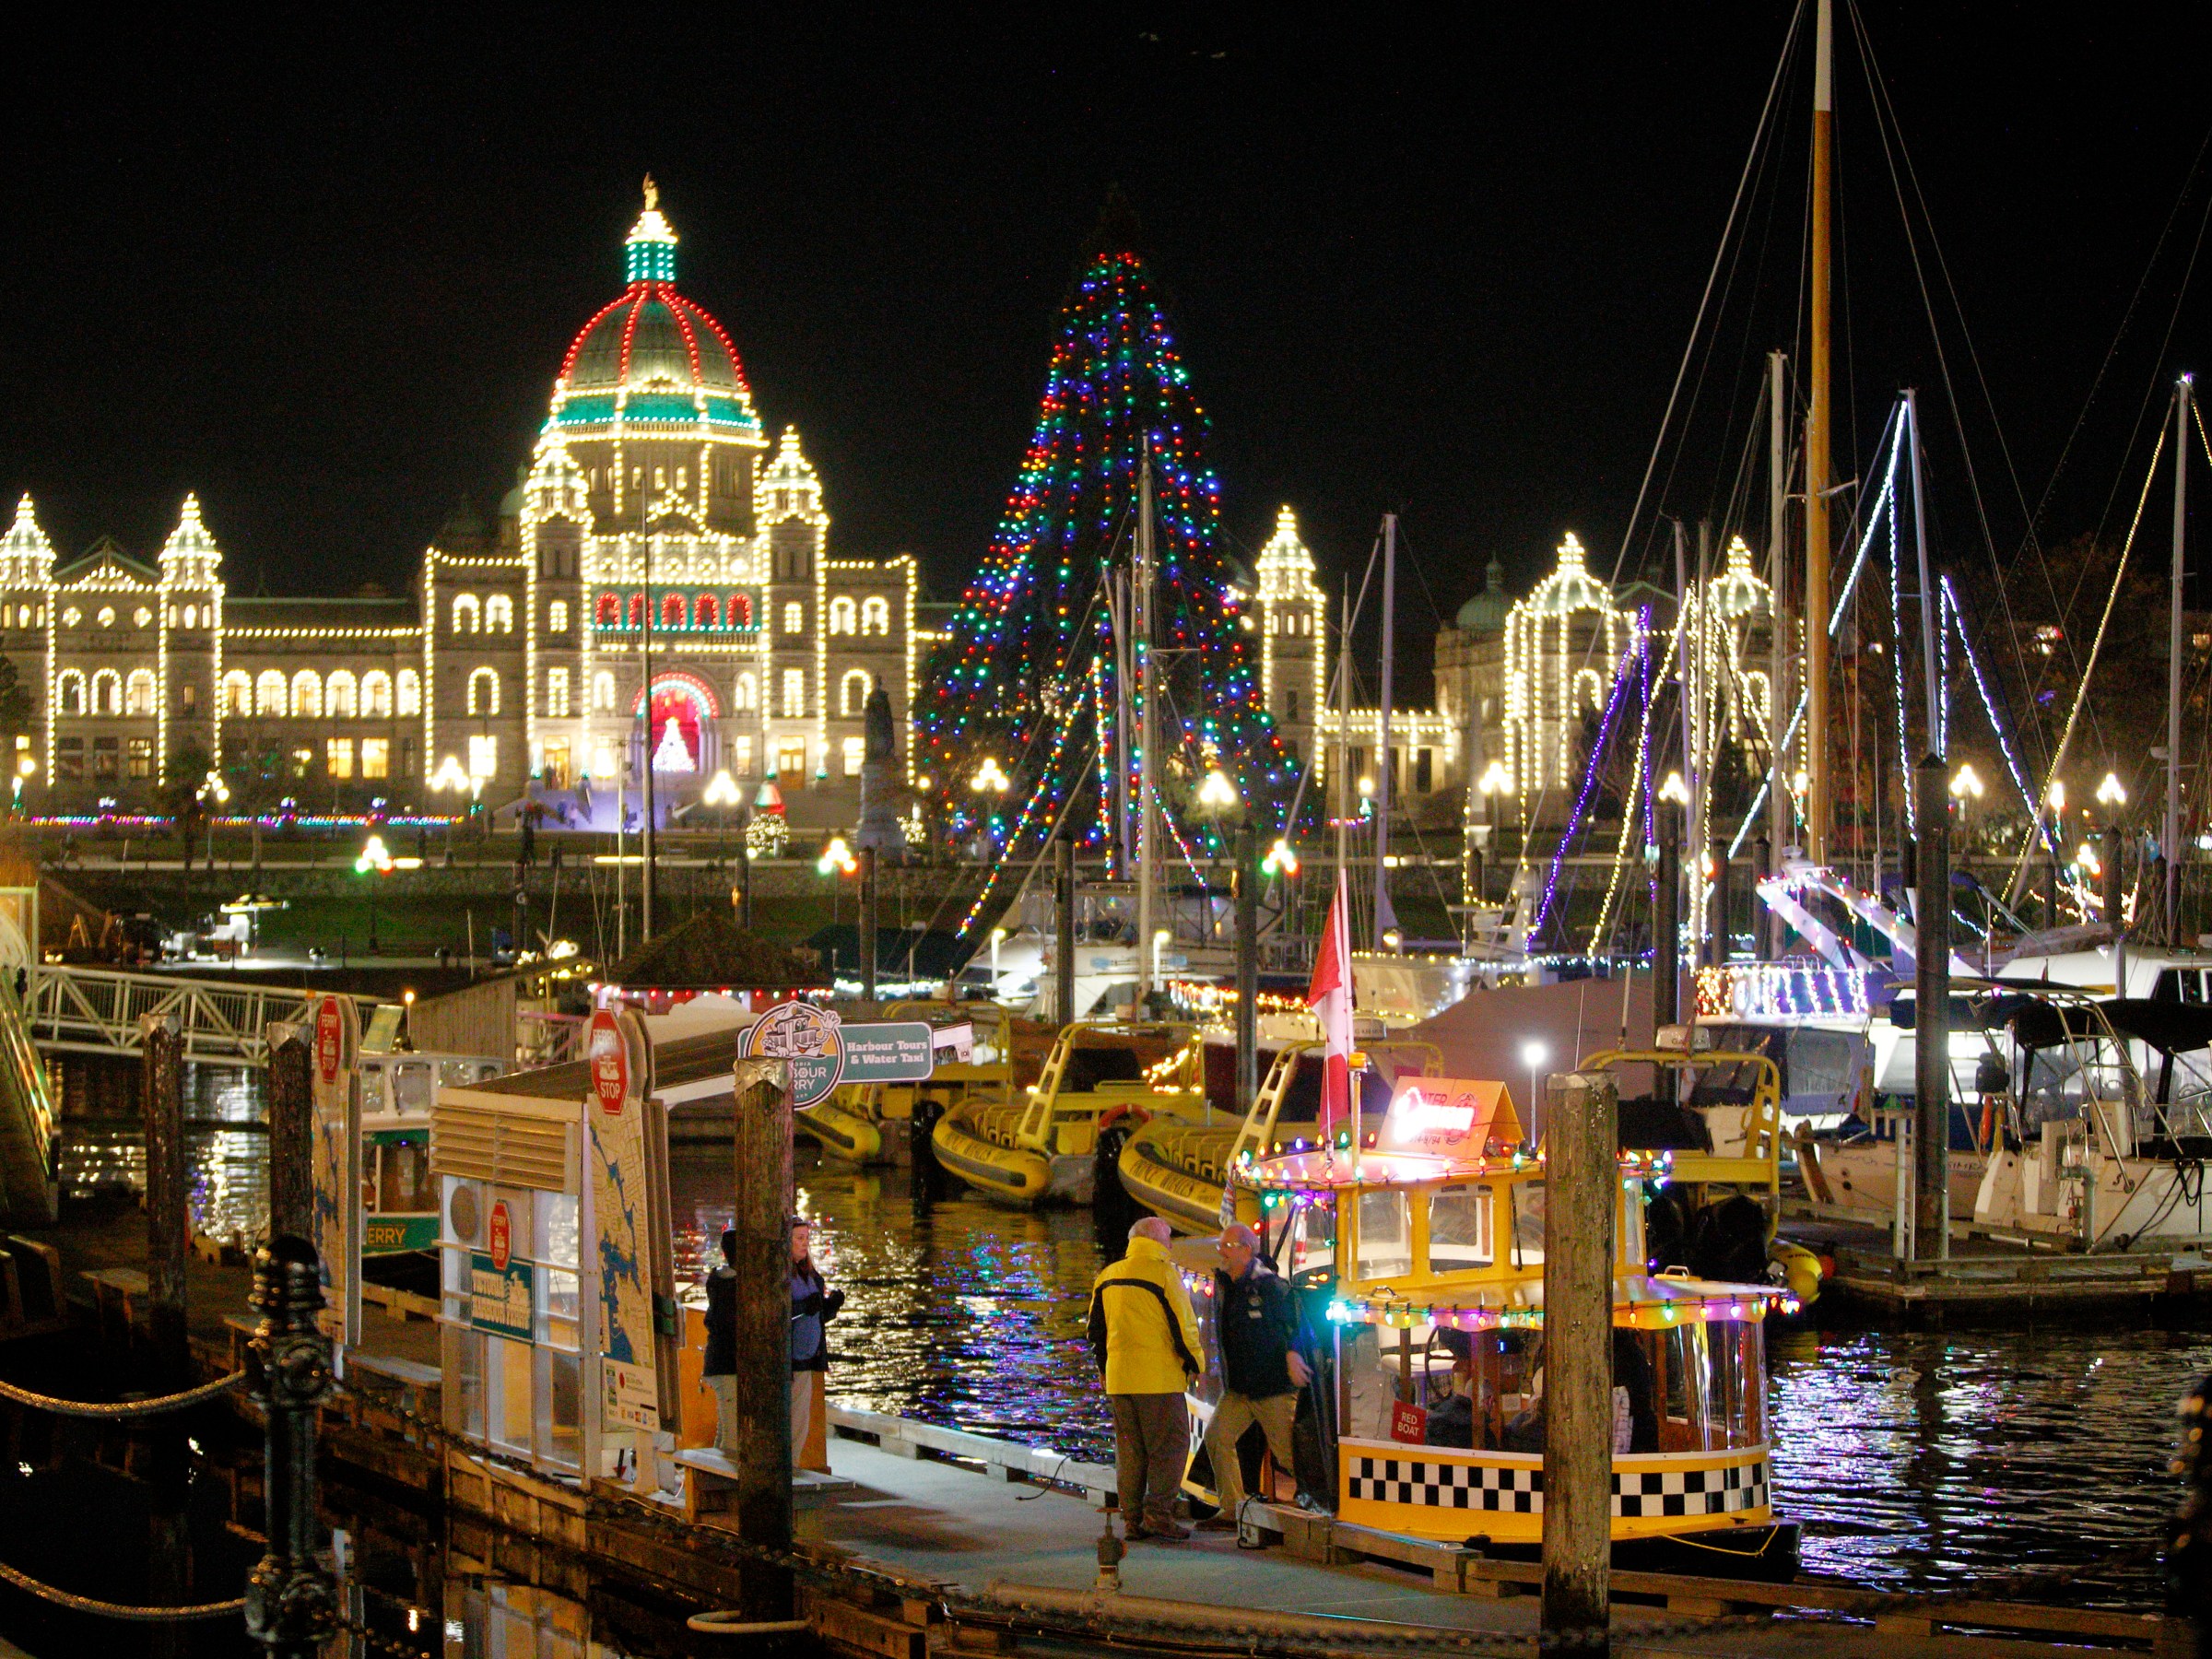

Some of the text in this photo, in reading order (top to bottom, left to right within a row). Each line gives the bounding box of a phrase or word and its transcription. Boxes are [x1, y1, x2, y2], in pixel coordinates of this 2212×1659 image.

[846, 1039, 927, 1052] Harbour Tours
[850, 1053, 924, 1065] & Water Taxi
[793, 1066, 828, 1078] BOUR
[600, 1081, 621, 1100] STOP
[793, 1078, 816, 1090] RRY
[367, 1227, 406, 1245] ERRY
[1401, 1411, 1418, 1425] RED
[1397, 1421, 1419, 1436] BOAT
